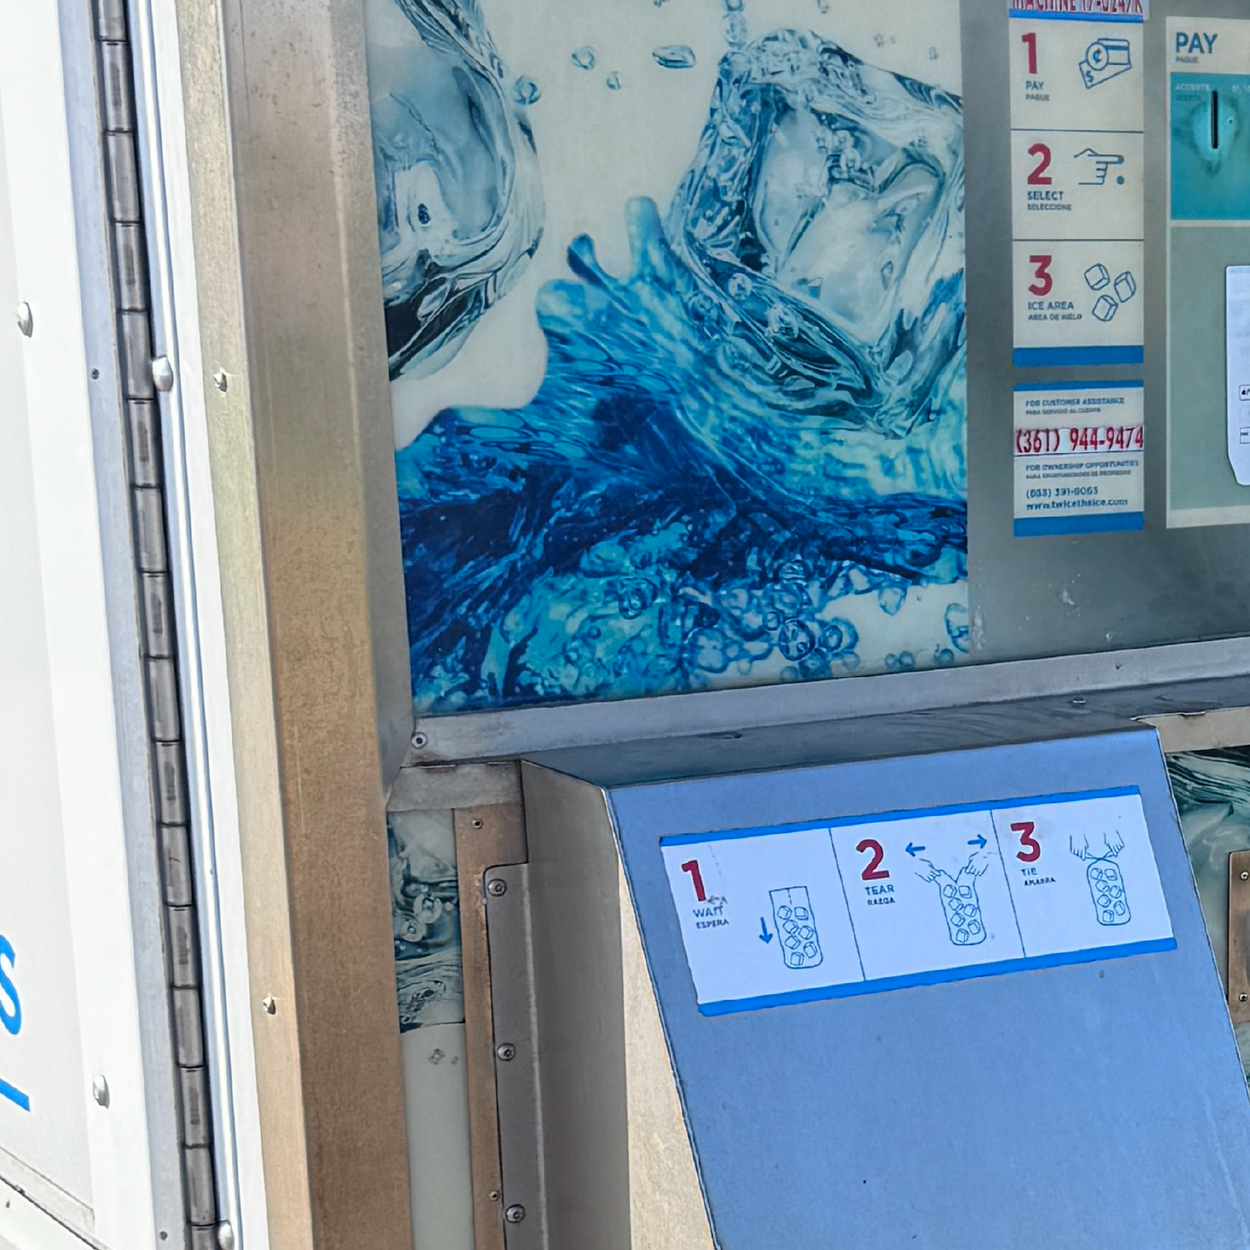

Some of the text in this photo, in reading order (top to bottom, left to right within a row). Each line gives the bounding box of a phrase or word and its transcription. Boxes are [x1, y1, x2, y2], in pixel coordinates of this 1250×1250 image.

[1021, 32, 1038, 74] 1
[1176, 31, 1218, 54] PAY
[1025, 80, 1044, 91] PAY
[1027, 142, 1053, 185] 2
[1027, 190, 1065, 201] SELECT
[1028, 254, 1053, 296] 3
[1028, 301, 1075, 310] ICE AREA
[1025, 399, 1040, 407] FOR
[1015, 425, 1144, 453] (361) 944-9474
[1010, 821, 1041, 863] 3
[855, 838, 890, 881] 2
[681, 859, 707, 902] 1
[1021, 867, 1038, 876] TIE
[864, 884, 895, 896] TEAR
[692, 905, 724, 918] WAIT
